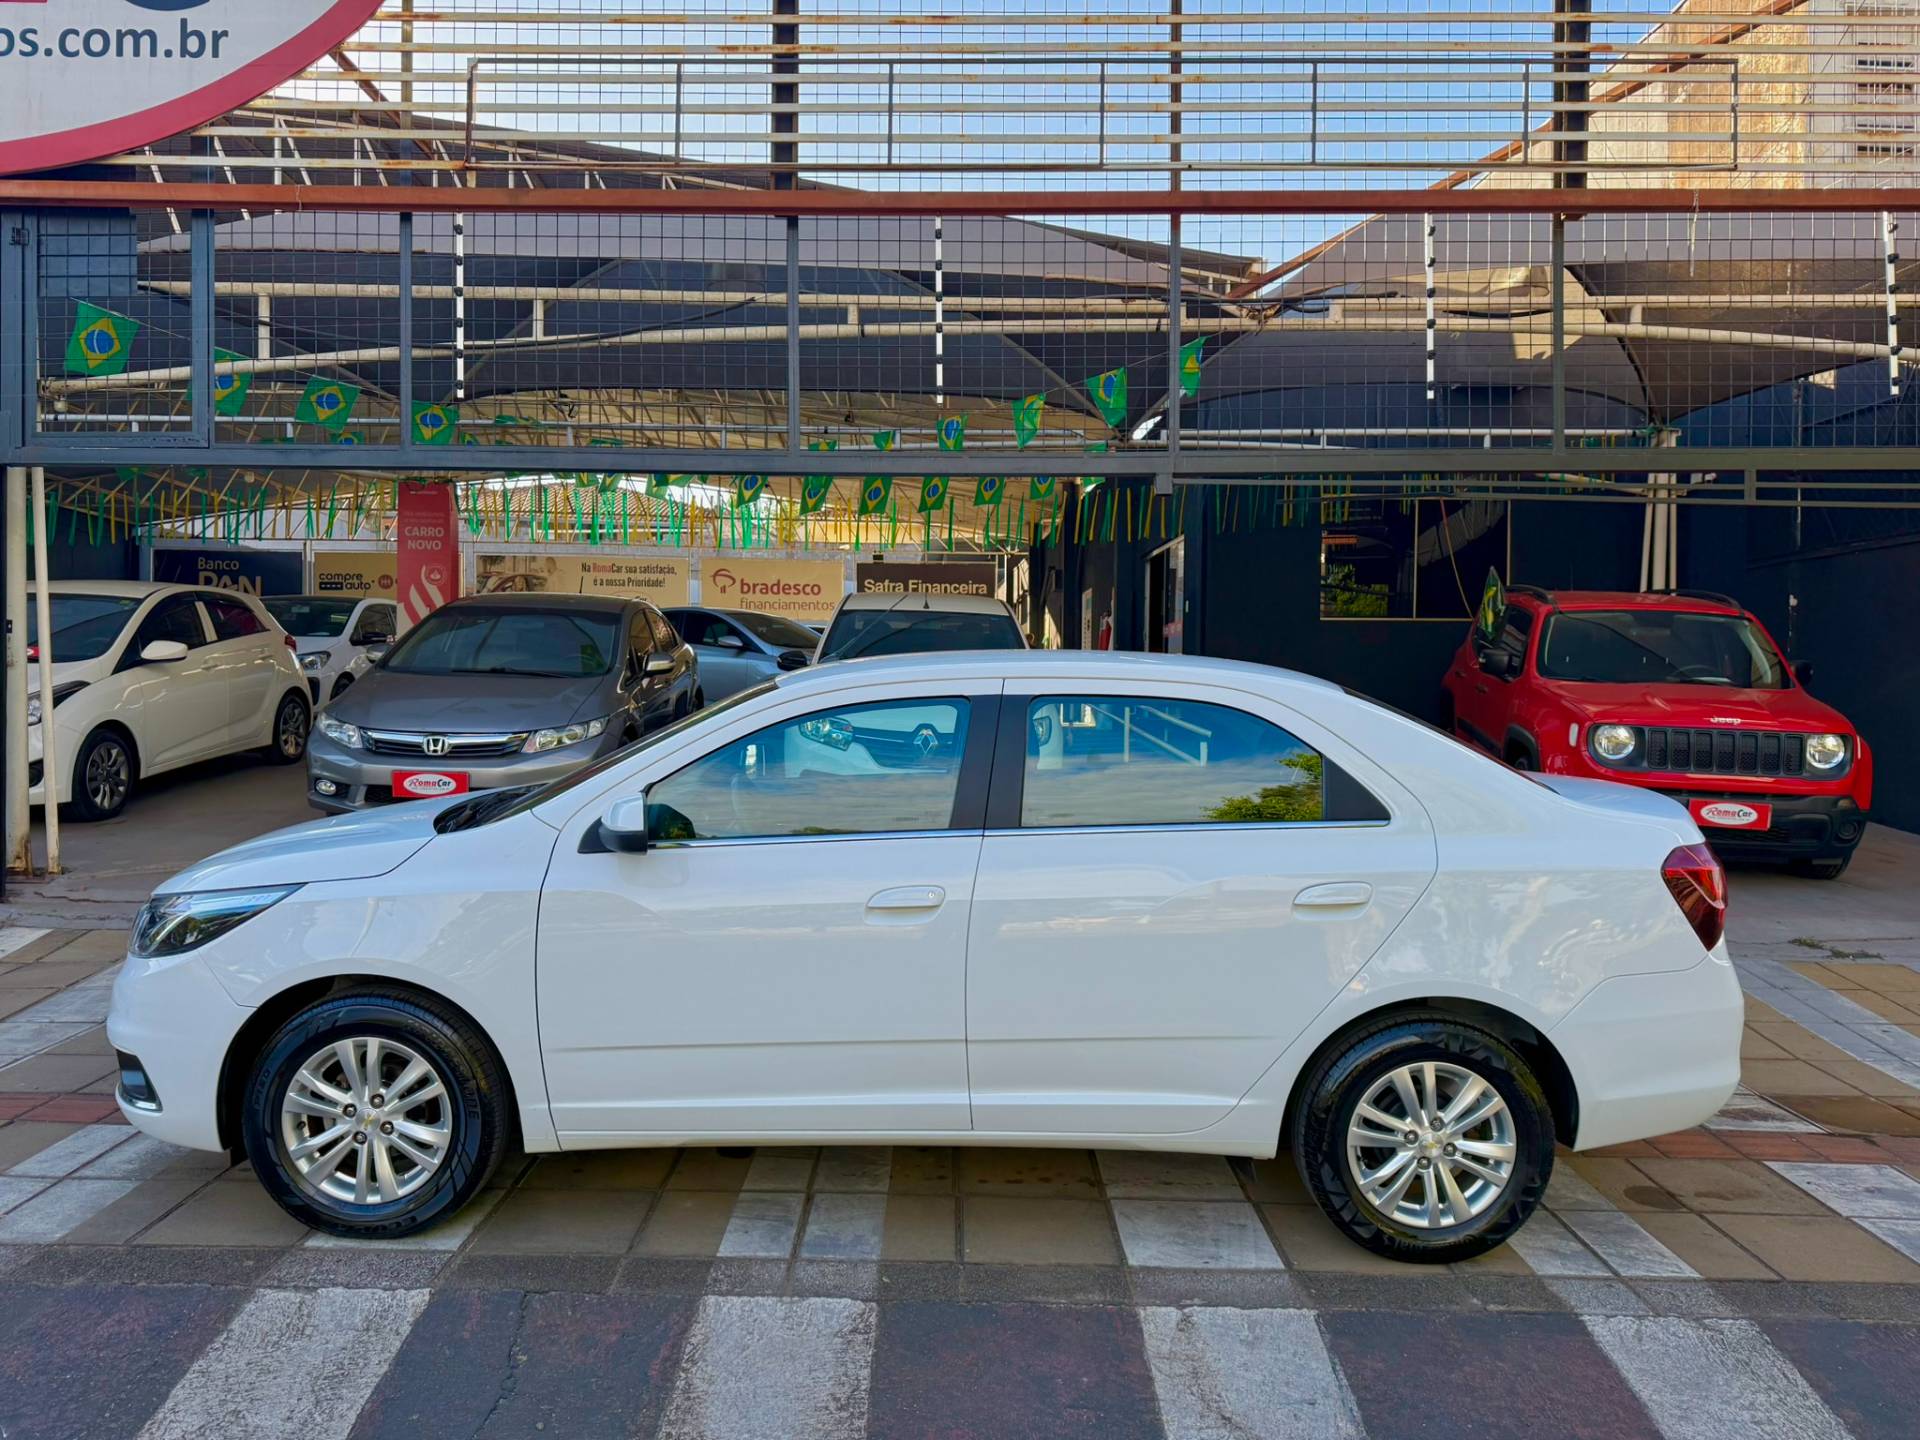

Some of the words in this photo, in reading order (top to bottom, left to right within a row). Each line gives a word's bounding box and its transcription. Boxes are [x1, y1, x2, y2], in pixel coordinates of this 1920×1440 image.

[404, 526, 444, 537] CARRO
[407, 540, 442, 550] NOVO
[198, 557, 239, 570] Banco
[581, 563, 591, 573] Na
[592, 563, 622, 574] RomaCar
[625, 565, 637, 574] sua
[319, 573, 363, 583] compre
[605, 578, 625, 587] nossa
[627, 577, 666, 588] Prioridade!
[345, 581, 371, 590] auto
[740, 578, 821, 596] bradesco
[864, 579, 904, 593] Safra
[908, 579, 988, 595] Financeira
[740, 597, 835, 611] financiamentos
